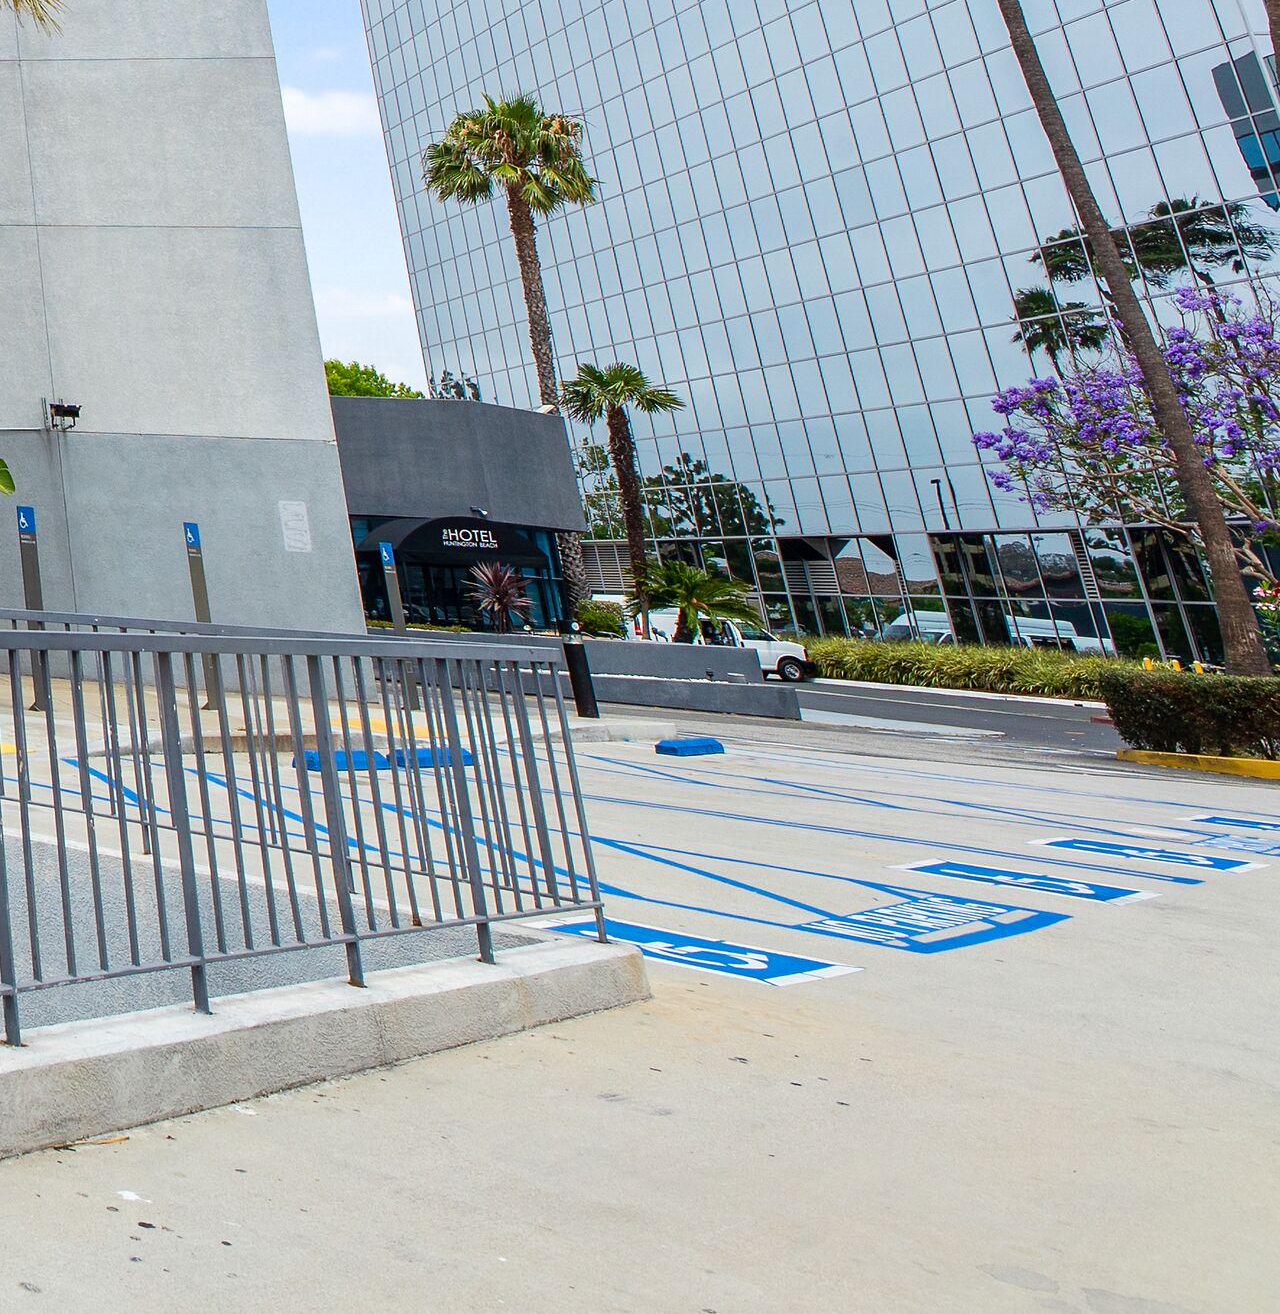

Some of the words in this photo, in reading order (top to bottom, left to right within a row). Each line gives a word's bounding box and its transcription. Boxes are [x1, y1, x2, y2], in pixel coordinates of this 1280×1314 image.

[443, 540, 478, 548] HUNTINGTON
[479, 541, 499, 549] BEACH
[447, 528, 498, 543] HOTEL
[845, 897, 1009, 934] PARKING
[801, 918, 910, 943] NO
